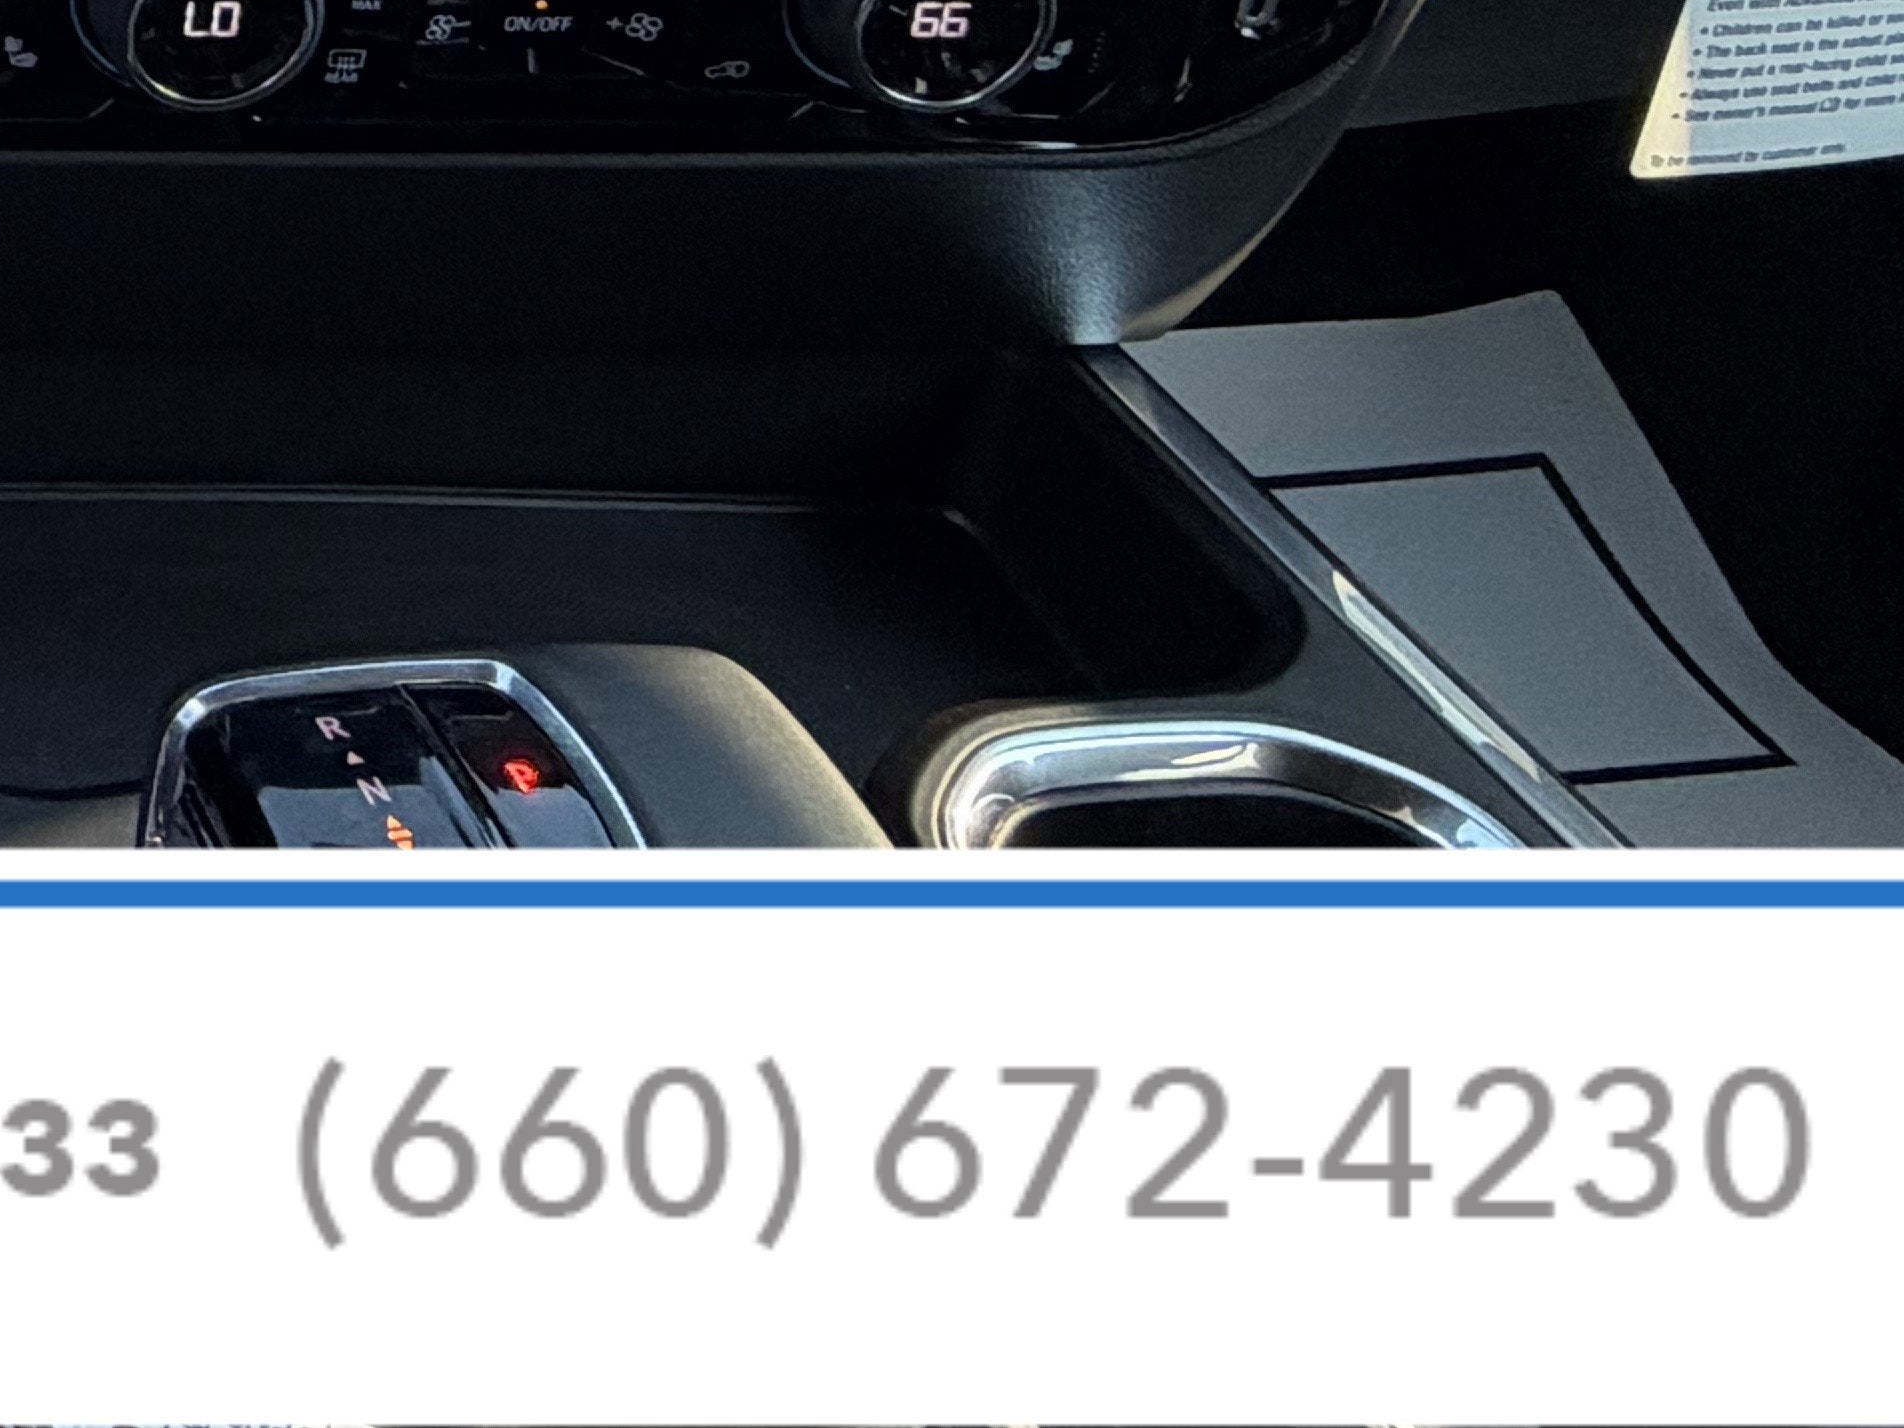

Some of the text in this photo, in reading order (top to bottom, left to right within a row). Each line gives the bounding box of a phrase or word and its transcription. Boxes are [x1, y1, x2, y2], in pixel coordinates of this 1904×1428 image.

[183, 0, 242, 39] LO
[503, 15, 574, 33] ON/OFF
[909, 0, 972, 40] 66
[313, 715, 352, 742] R
[355, 775, 392, 807] N
[502, 758, 540, 795] P
